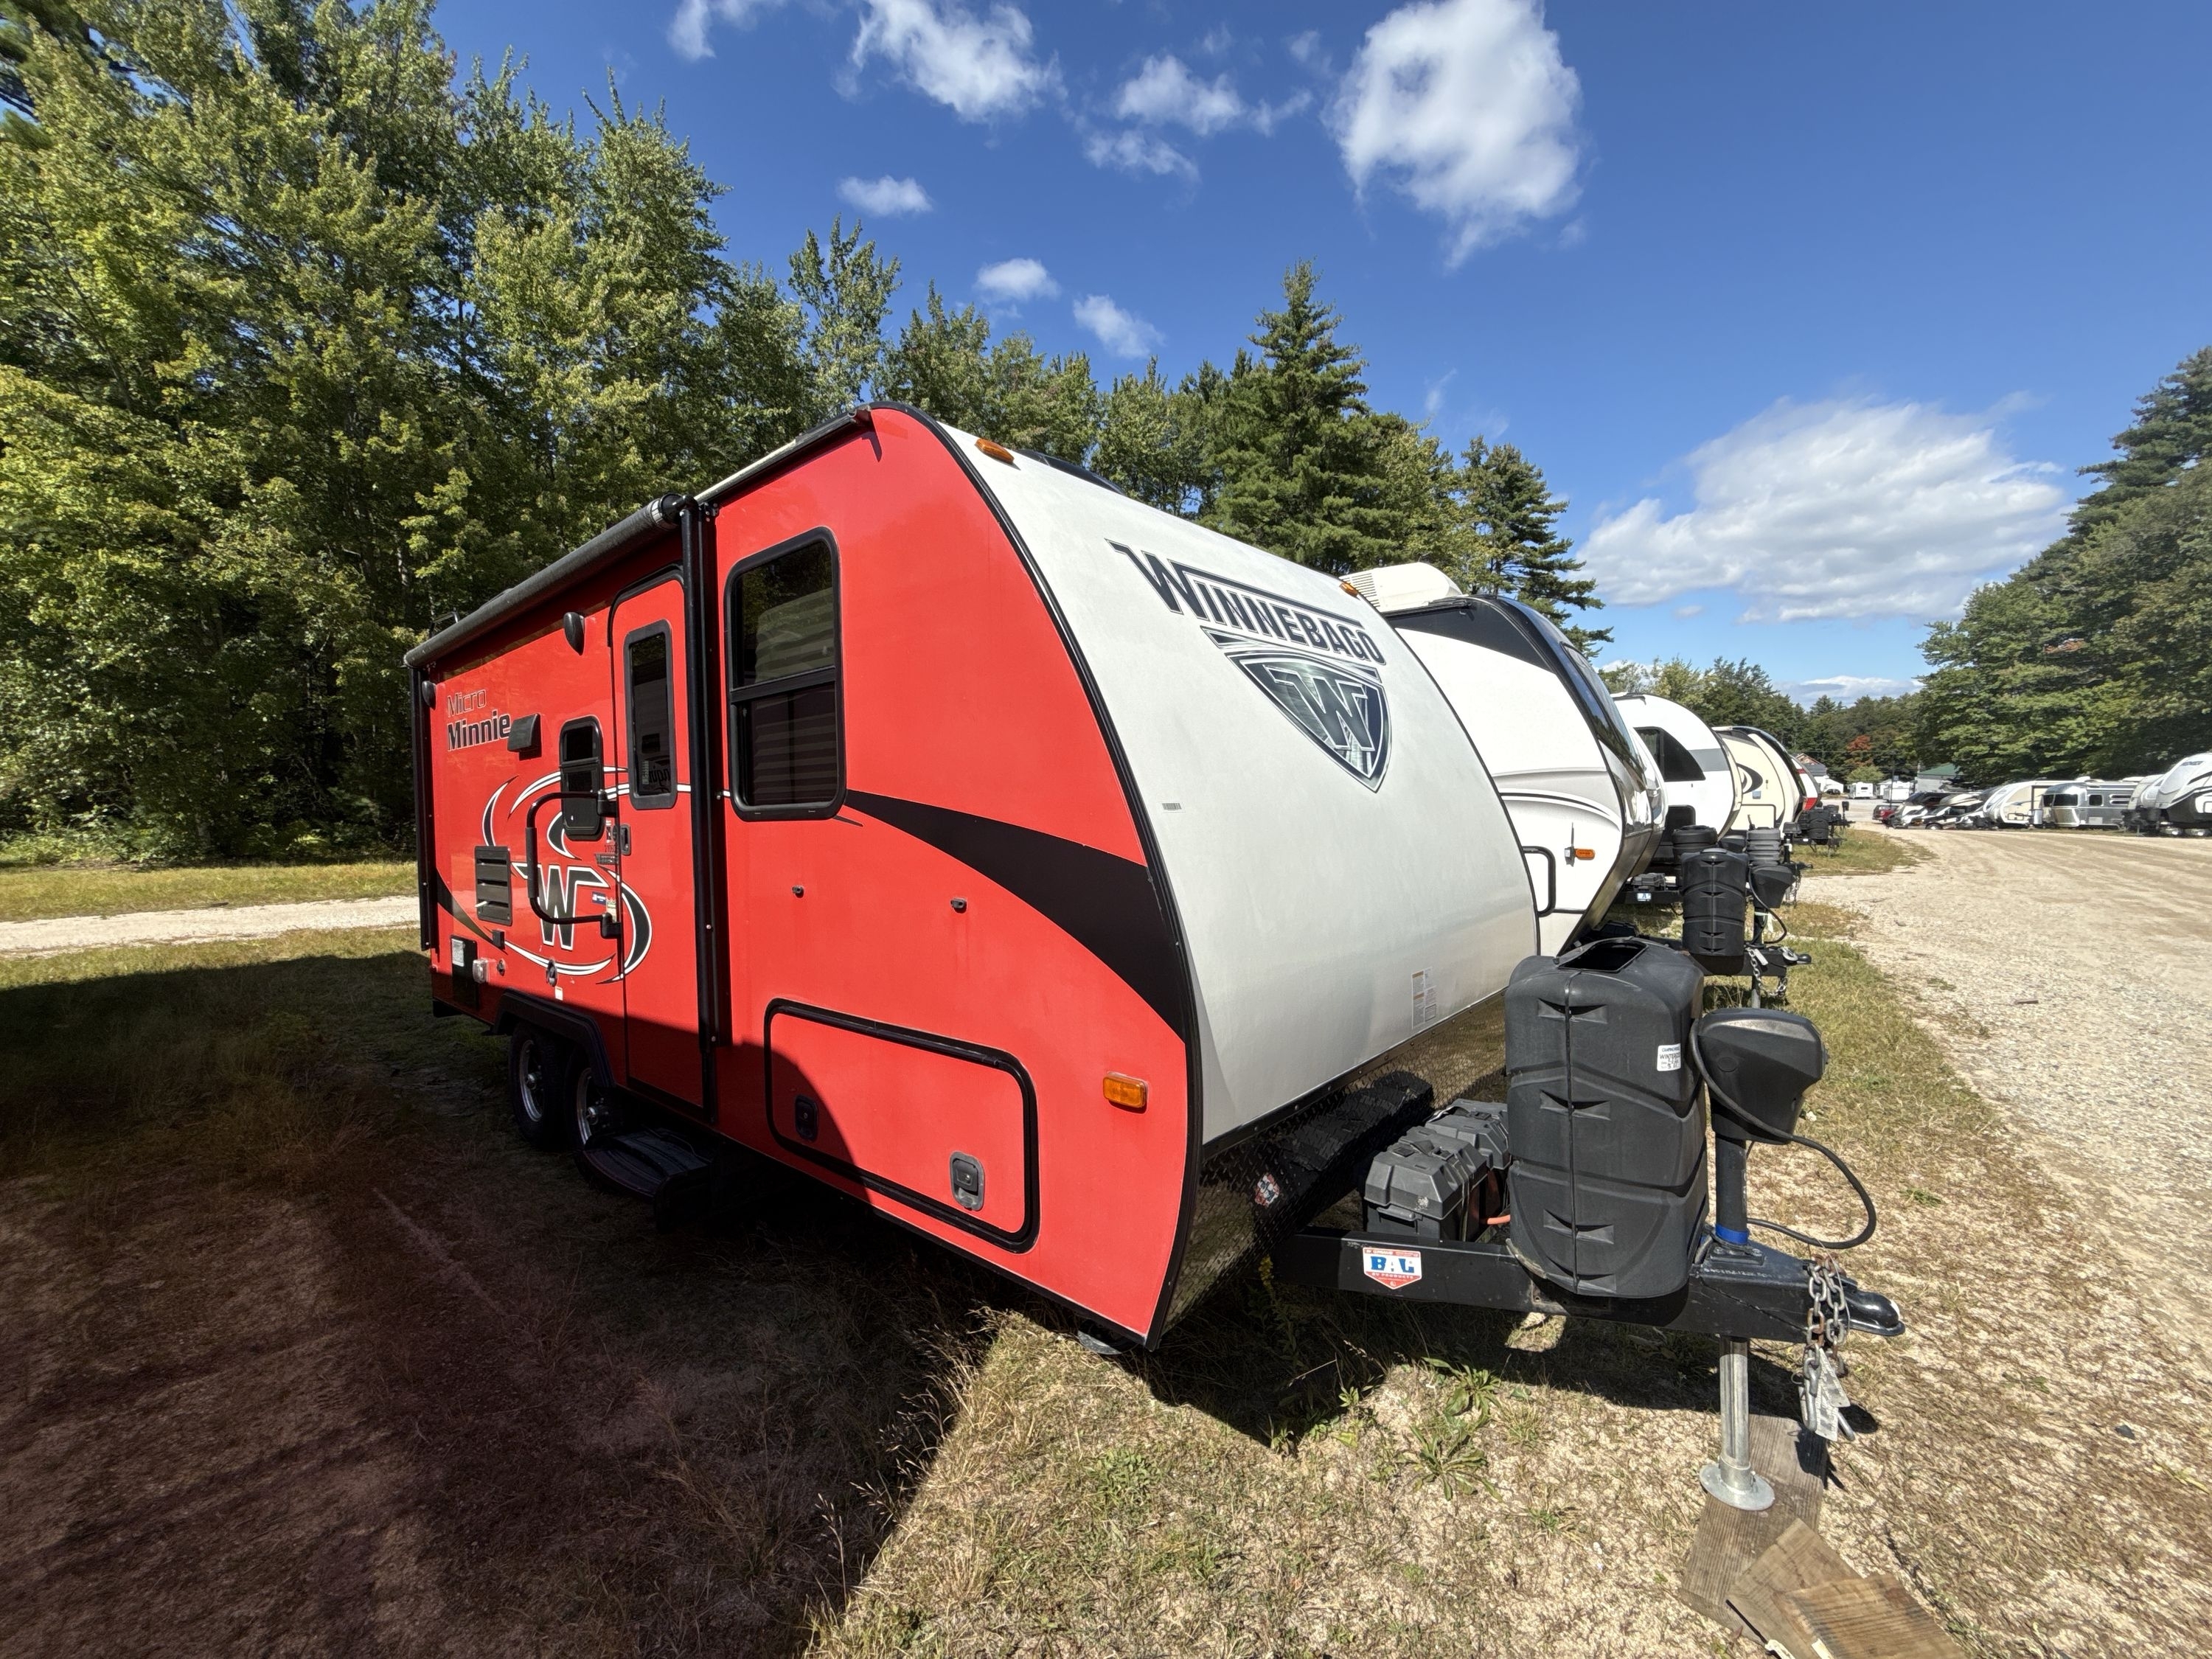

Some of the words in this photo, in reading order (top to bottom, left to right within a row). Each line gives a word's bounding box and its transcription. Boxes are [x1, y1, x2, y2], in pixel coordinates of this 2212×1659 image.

[1104, 538, 1387, 665] WINNEBAGO
[447, 689, 487, 717] Micro
[447, 709, 511, 751] Minnie
[1264, 665, 1374, 751] W
